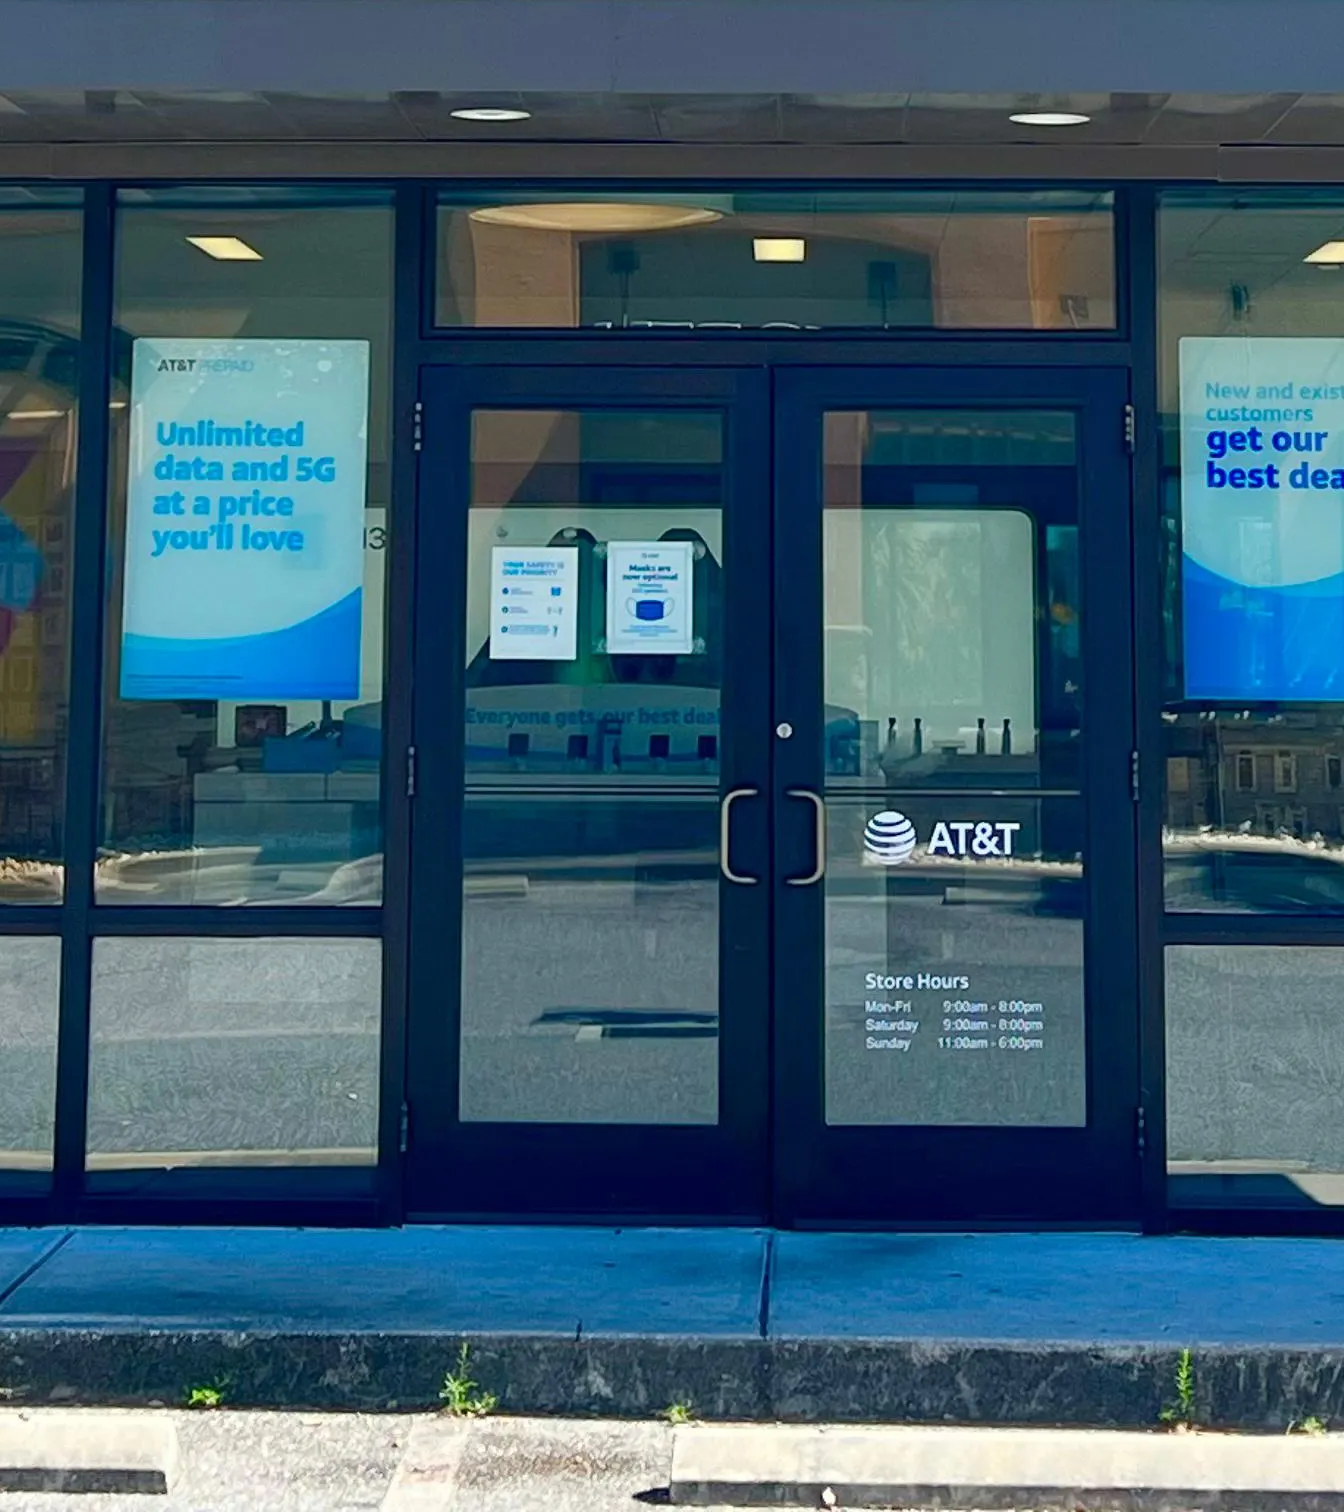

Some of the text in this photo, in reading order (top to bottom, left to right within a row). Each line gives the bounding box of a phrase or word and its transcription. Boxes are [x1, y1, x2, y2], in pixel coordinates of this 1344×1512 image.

[157, 358, 196, 371] AT&T
[1205, 382, 1250, 399] New
[1256, 382, 1293, 400] and
[1205, 406, 1314, 422] customers
[156, 419, 304, 448] Unlimited
[1206, 426, 1329, 459] get our
[154, 453, 336, 483] data and 5G
[1206, 460, 1280, 489] best
[152, 488, 294, 524] at a price
[150, 523, 304, 557] you'll love
[465, 707, 551, 728] Everyone
[556, 708, 595, 728] gets
[637, 706, 679, 725] best
[926, 821, 1021, 855] AT&T
[865, 973, 969, 990] Store Hours
[865, 1000, 912, 1013] Mon-Fri
[942, 1000, 989, 1013] 9:00am
[998, 1000, 1044, 1016] 8:00pm
[865, 1019, 919, 1034] Saturday
[942, 1018, 989, 1032] 9:00am
[998, 1018, 1044, 1034] 8:00pm
[866, 1036, 912, 1053] Sunday
[937, 1036, 988, 1050] 11:00am
